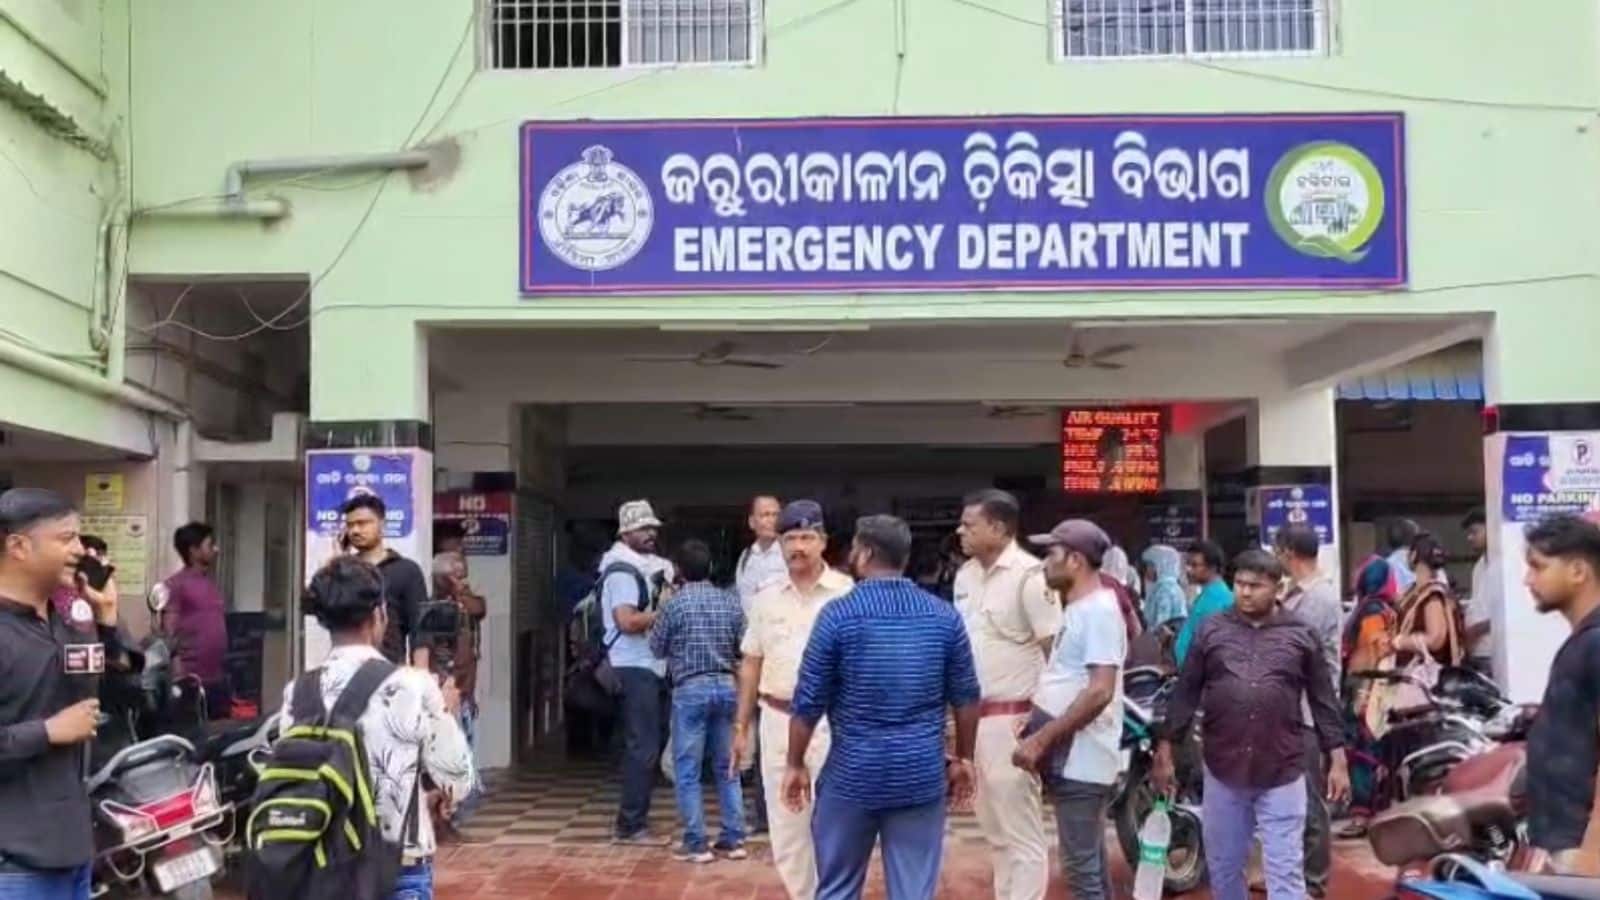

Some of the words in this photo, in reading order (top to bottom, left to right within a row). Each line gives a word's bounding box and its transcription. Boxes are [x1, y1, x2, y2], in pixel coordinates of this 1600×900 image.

[1112, 130, 1251, 203] ବିଭାଗ
[673, 224, 944, 272] EMERGENCY
[957, 222, 1250, 270] DEPARTMENT
[1067, 410, 1093, 424] AIR
[1095, 411, 1160, 425] QUALITY
[459, 495, 486, 511] NO
[1510, 493, 1534, 505] NO
[316, 510, 338, 521] NO
